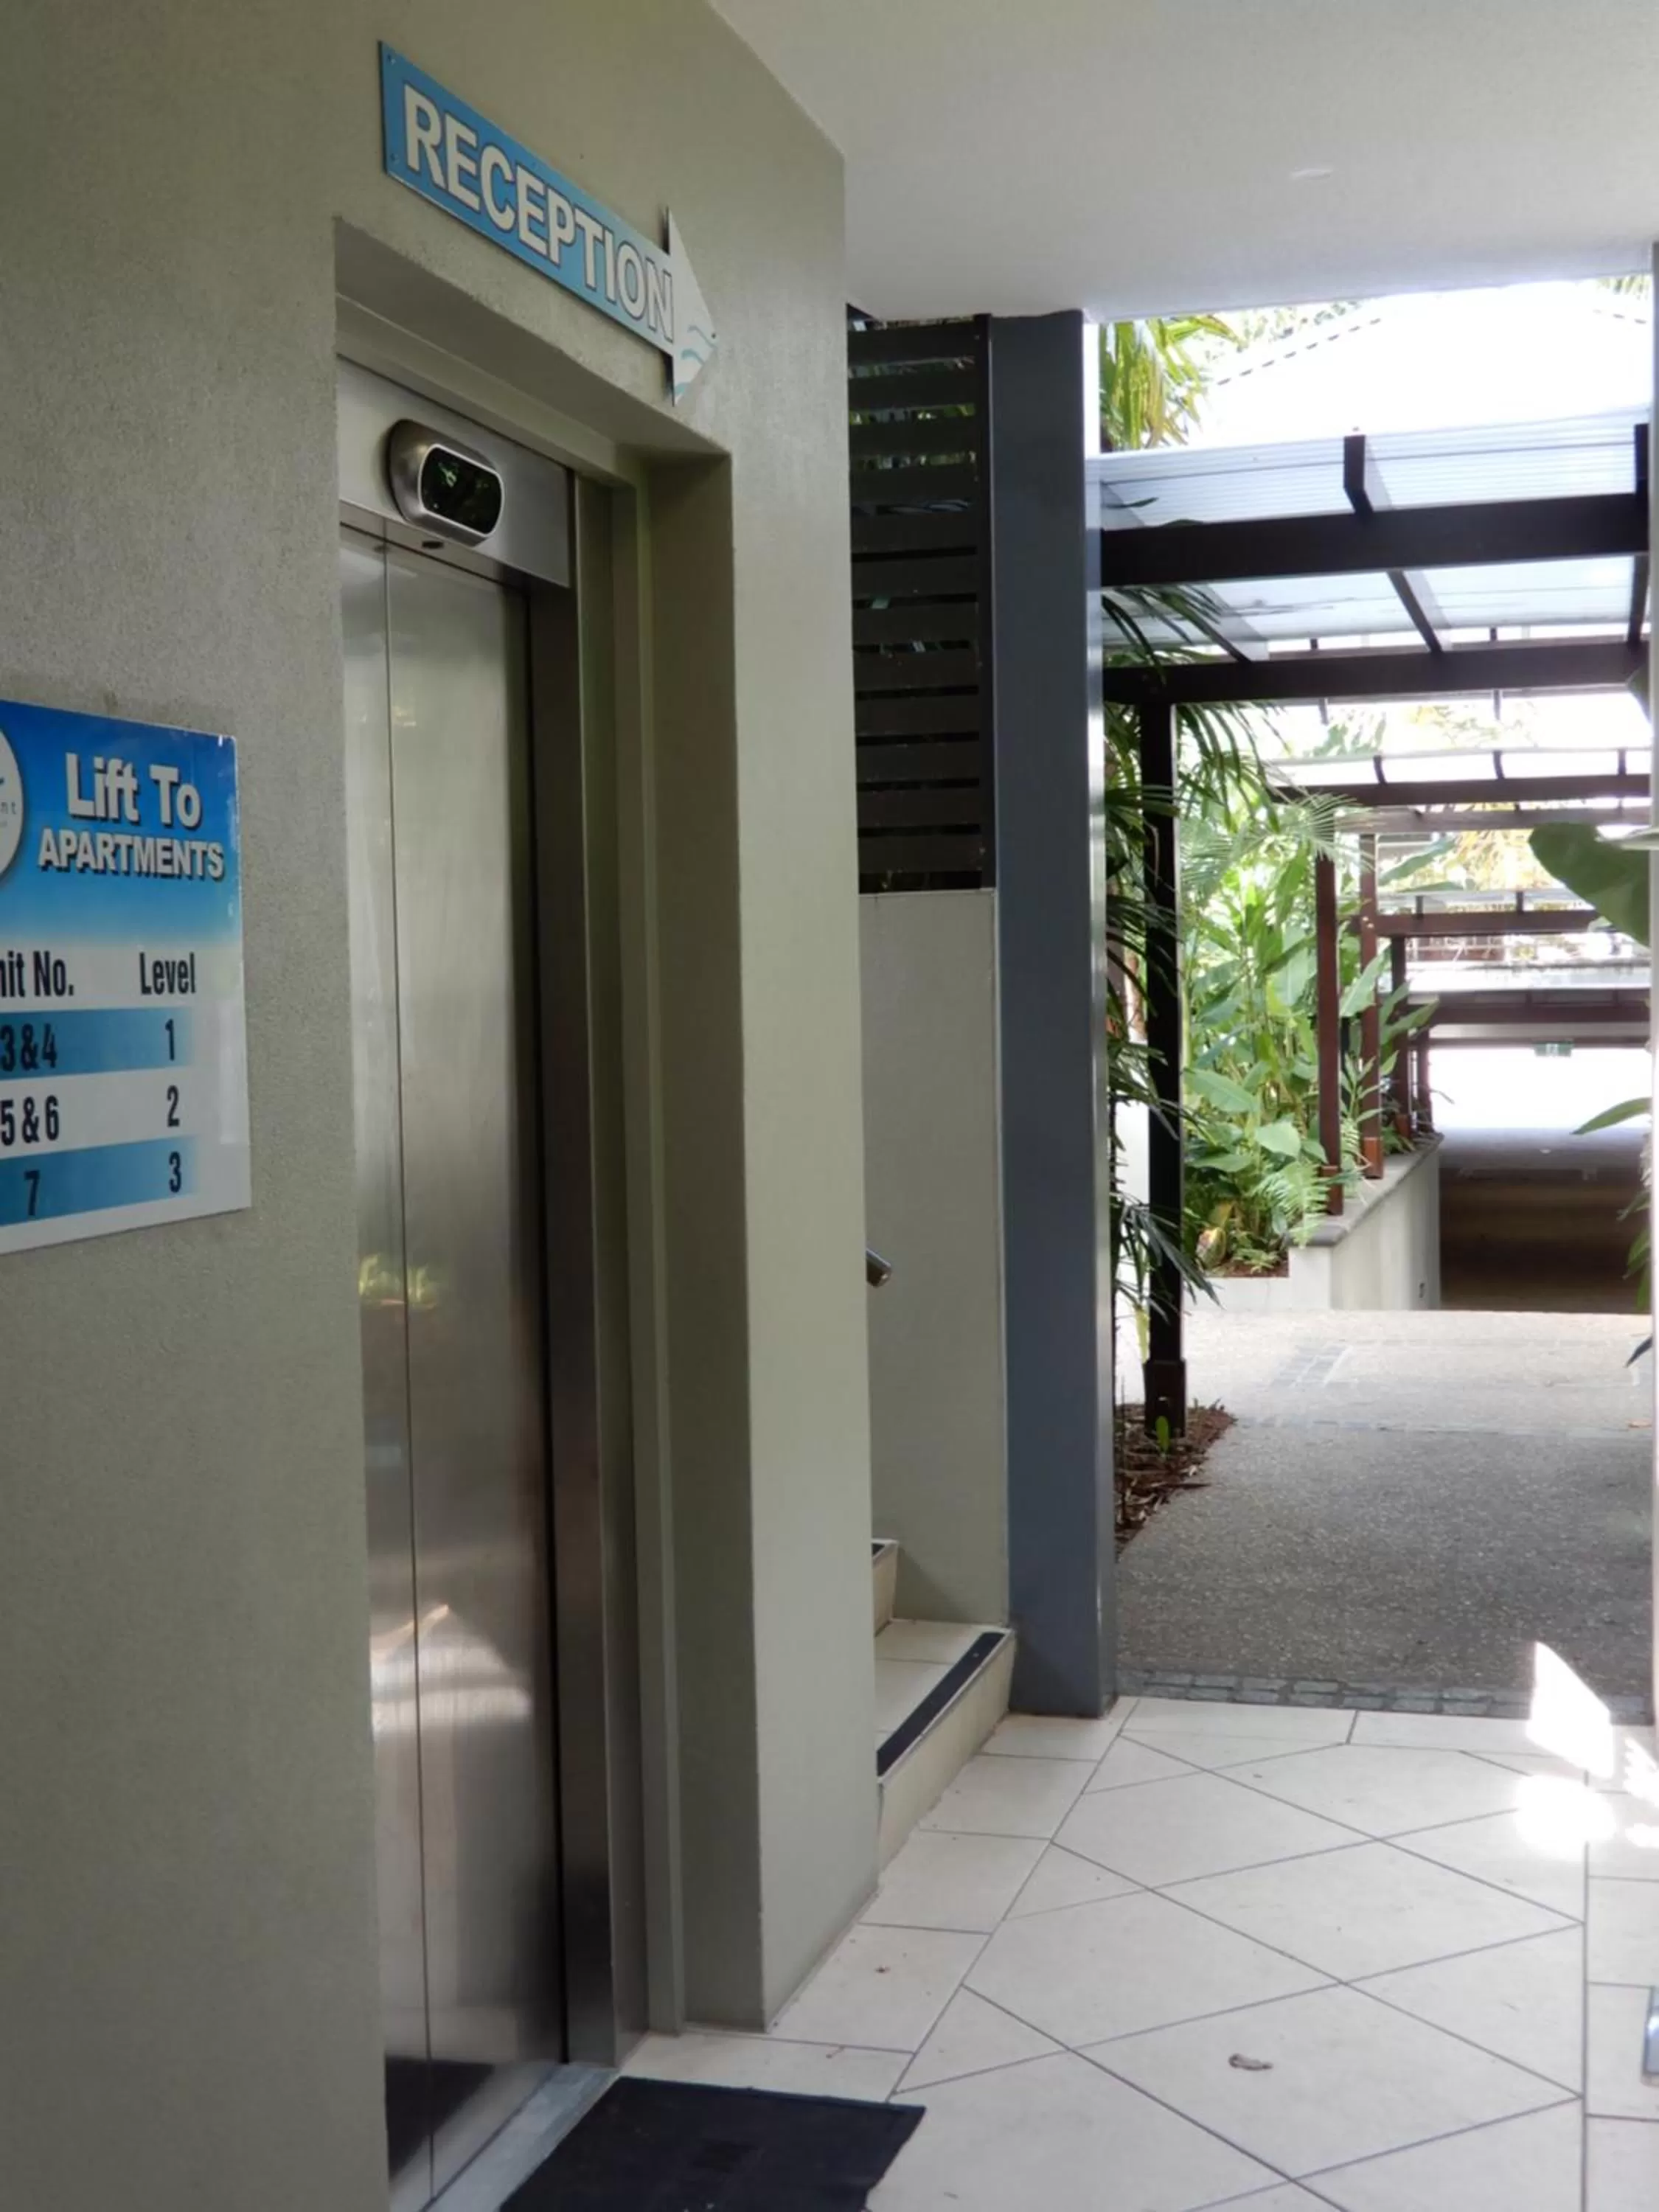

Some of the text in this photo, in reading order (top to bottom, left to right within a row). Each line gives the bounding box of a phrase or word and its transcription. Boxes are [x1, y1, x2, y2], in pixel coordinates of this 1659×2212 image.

[403, 83, 674, 344] RECEPTION
[66, 752, 201, 828] Lift To
[38, 827, 224, 878] APARTMENTS
[33, 950, 74, 997] No.
[139, 952, 196, 995] Level
[165, 1018, 175, 1060] 1
[167, 1085, 180, 1128] 2
[24, 1170, 40, 1215] 7
[169, 1151, 182, 1193] 3
